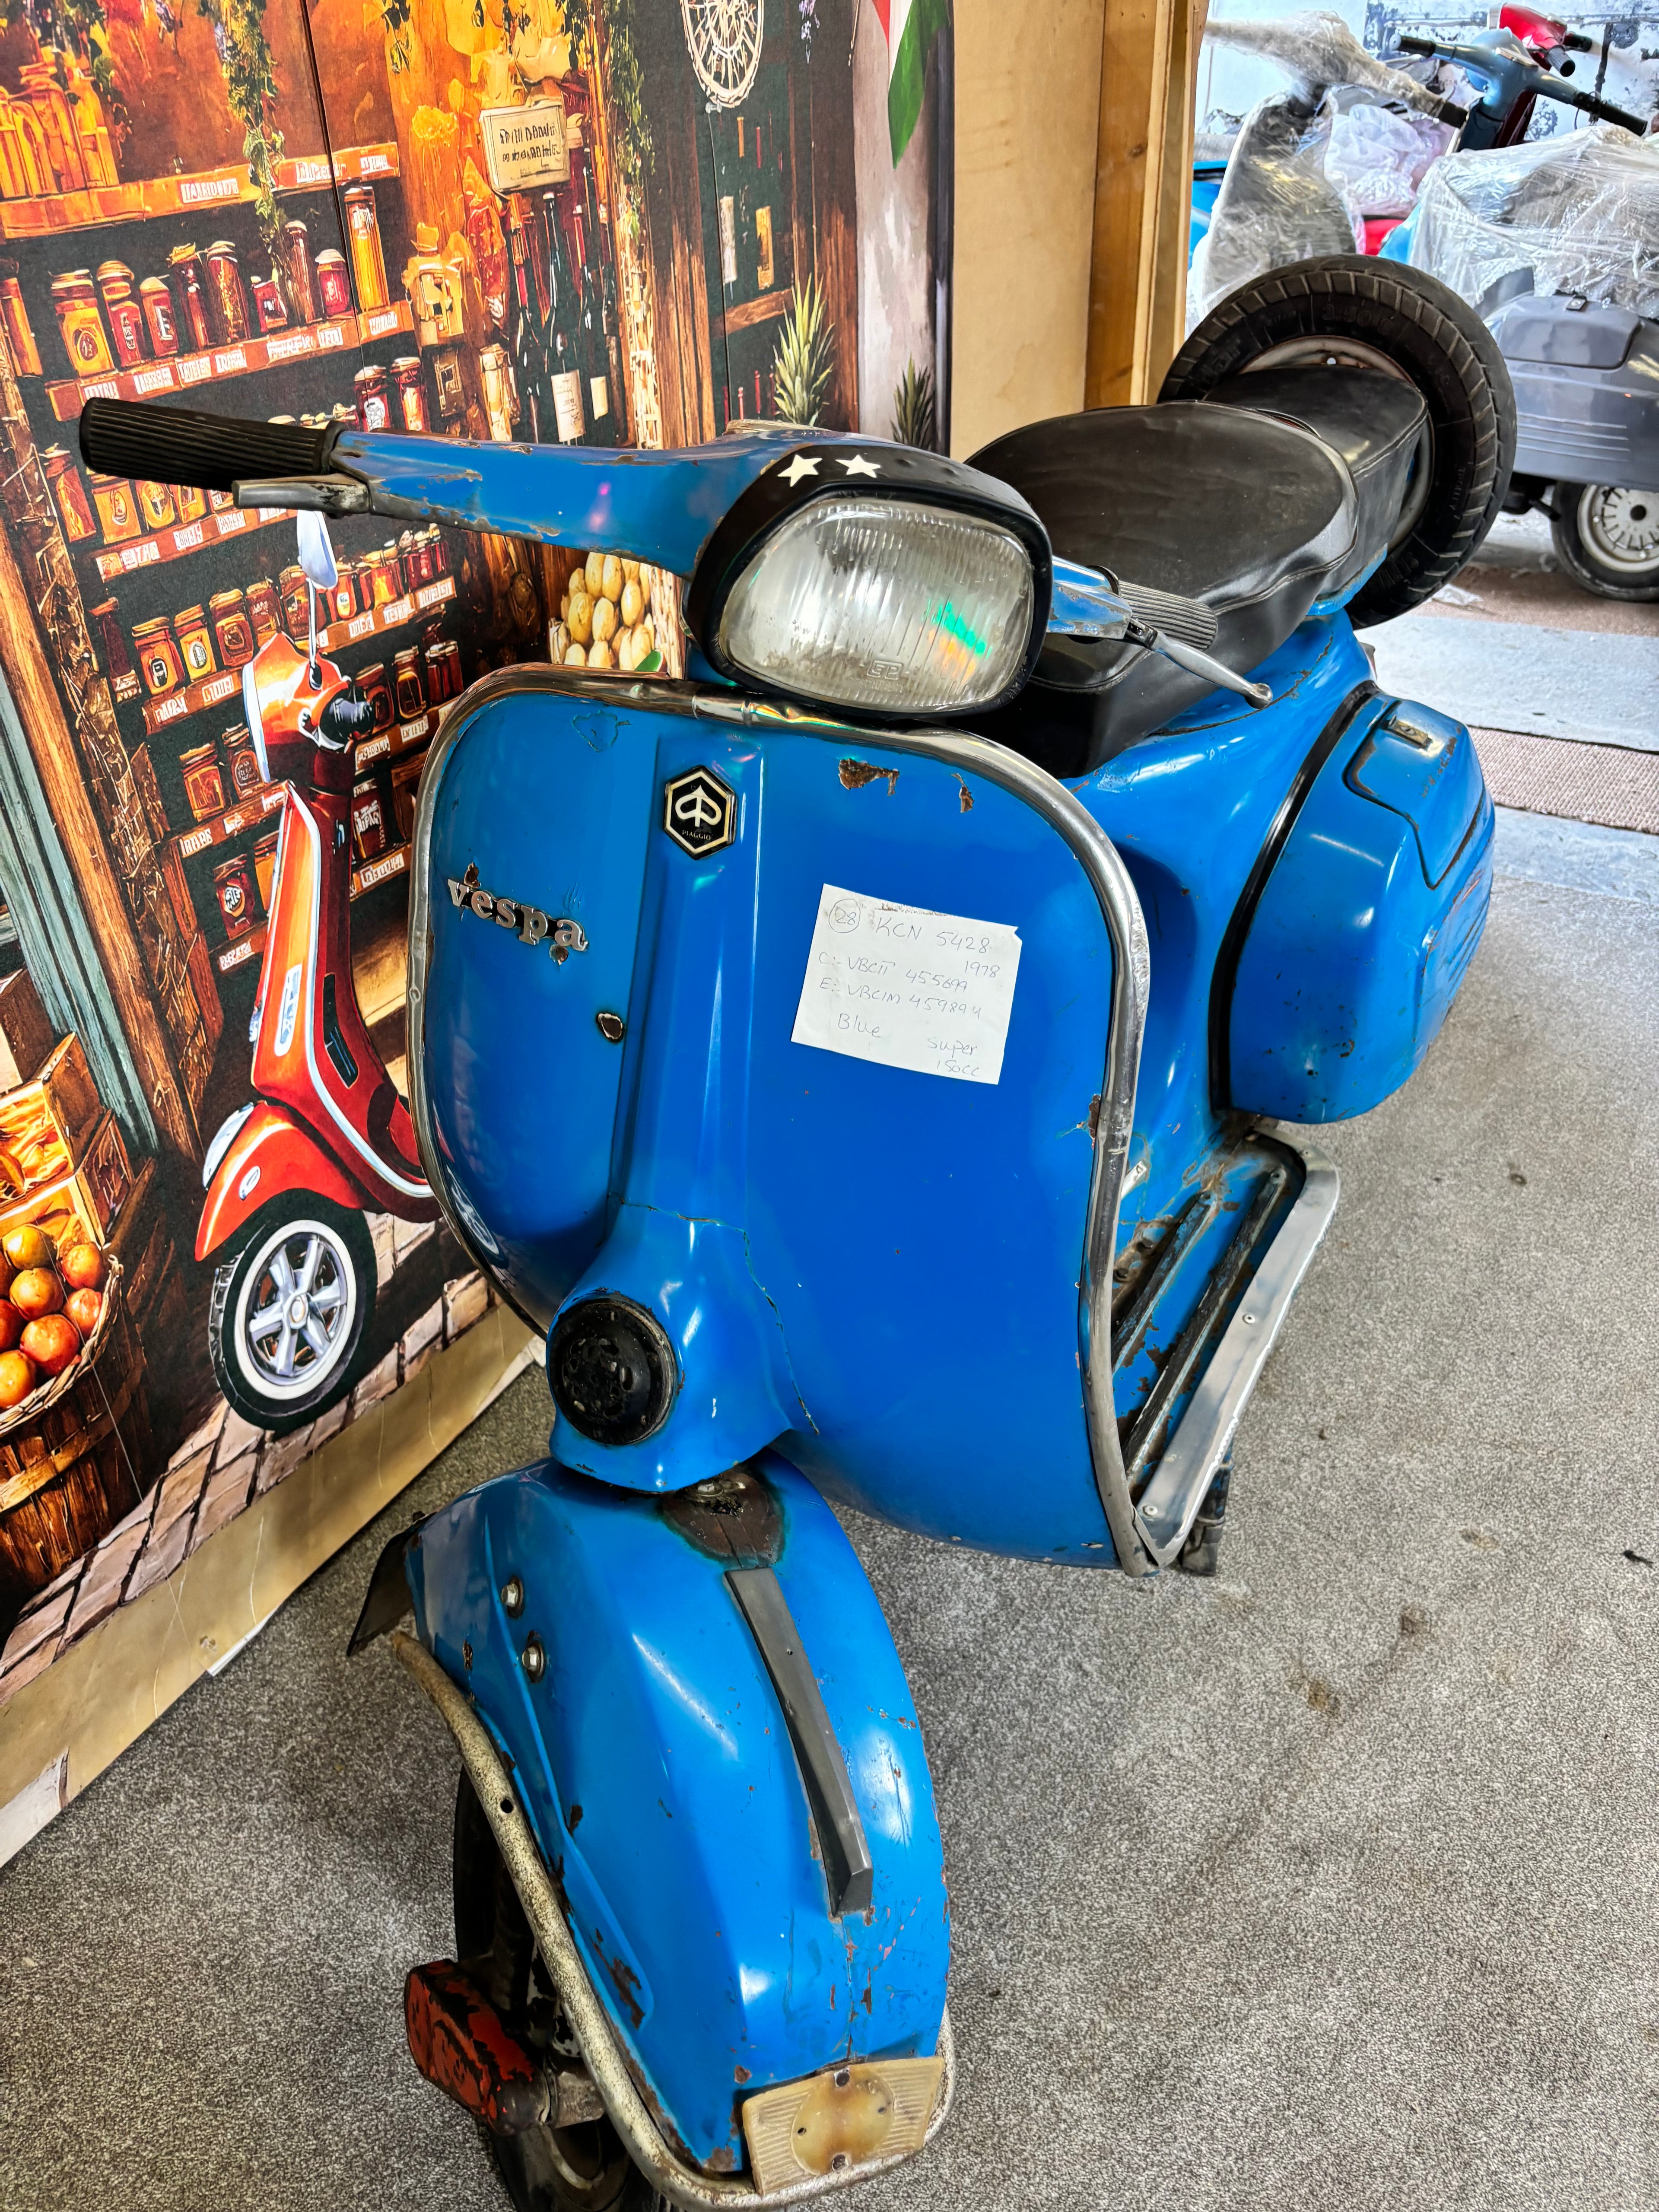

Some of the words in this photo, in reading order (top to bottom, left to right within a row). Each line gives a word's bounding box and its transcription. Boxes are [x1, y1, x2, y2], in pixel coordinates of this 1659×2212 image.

[682, 830, 711, 840] PIAGGIO
[448, 879, 588, 951] vespa
[836, 908, 857, 925] 28
[875, 917, 922, 941] KCN
[936, 931, 990, 953] 5428
[905, 969, 968, 993] 455699
[965, 960, 1001, 978] 1978
[838, 1013, 881, 1038] Blue
